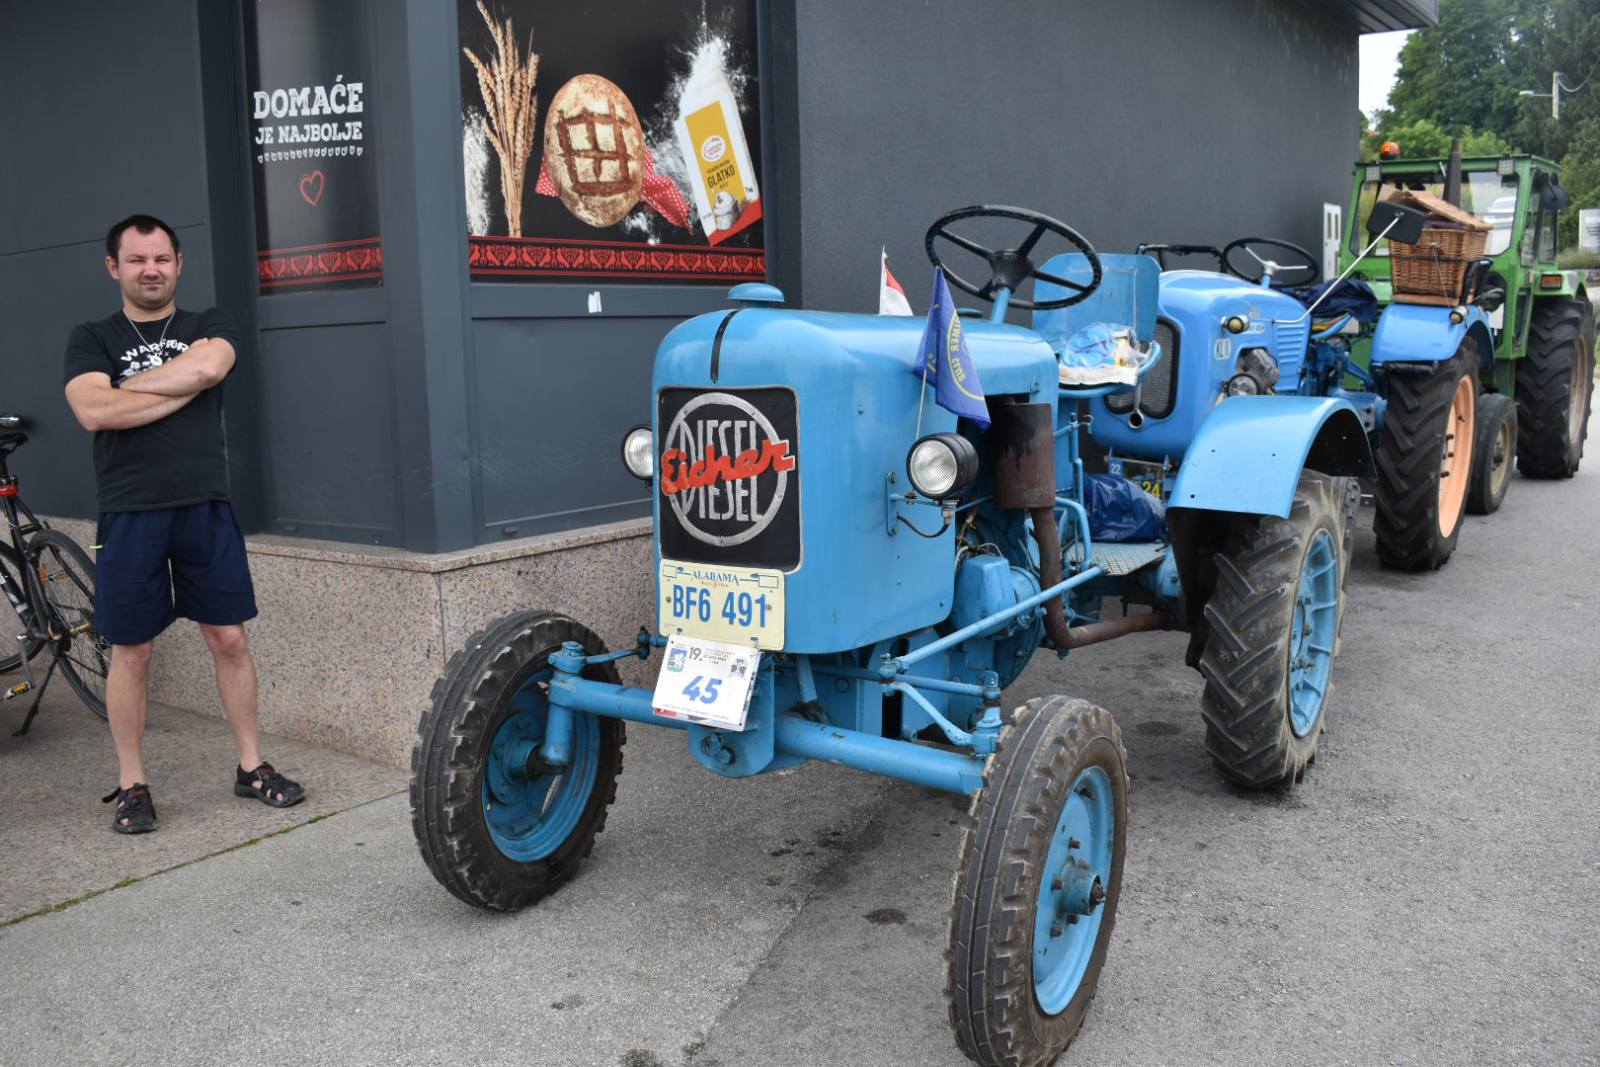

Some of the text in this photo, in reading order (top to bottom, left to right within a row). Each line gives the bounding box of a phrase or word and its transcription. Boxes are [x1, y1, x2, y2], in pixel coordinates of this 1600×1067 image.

[254, 75, 364, 119] DOMAĆE
[255, 122, 363, 144] JE NAJBOLJE
[707, 165, 736, 189] GLATKO
[661, 439, 795, 495] Eicher
[679, 419, 764, 521] DIESEL
[691, 570, 740, 585] ALABAMA
[673, 585, 767, 628] BF6 491
[688, 646, 703, 661] 19.
[682, 675, 723, 704] 45
